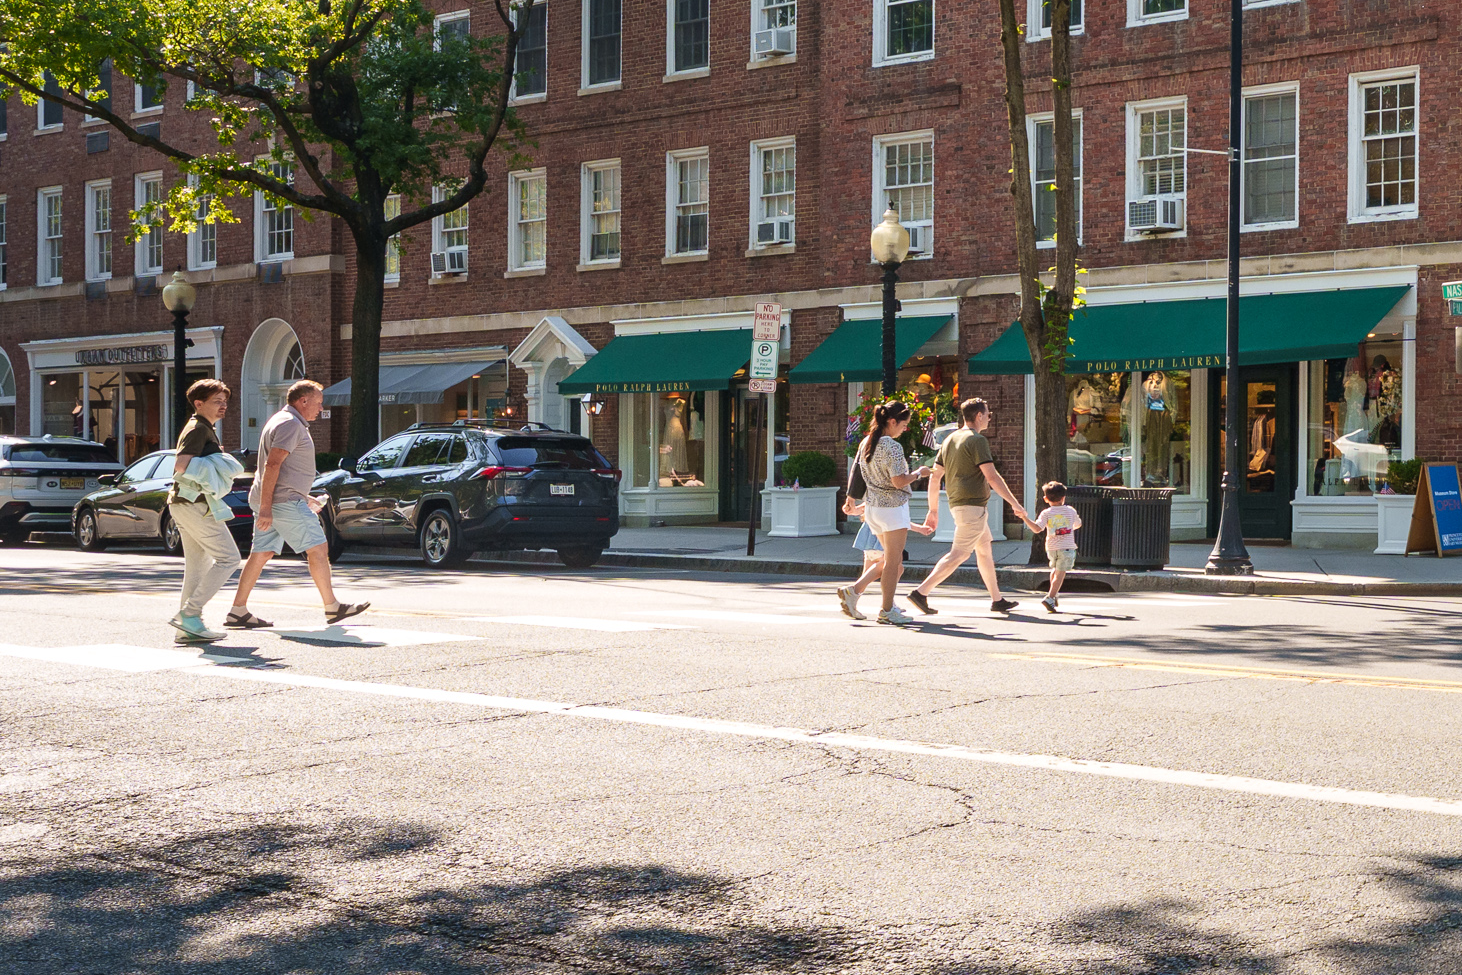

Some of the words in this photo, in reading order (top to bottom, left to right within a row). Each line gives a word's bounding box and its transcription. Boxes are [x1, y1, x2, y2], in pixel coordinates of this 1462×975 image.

[756, 313, 780, 321] PARKING
[1087, 361, 1117, 371] POLO
[1125, 359, 1164, 370] RALPH
[1172, 355, 1220, 368] LAUREN
[596, 384, 618, 392] POLO
[623, 383, 651, 392] RALPH
[656, 382, 690, 391] LAUREN
[378, 394, 396, 402] ARKER
[1436, 499, 1460, 511] OPEN
